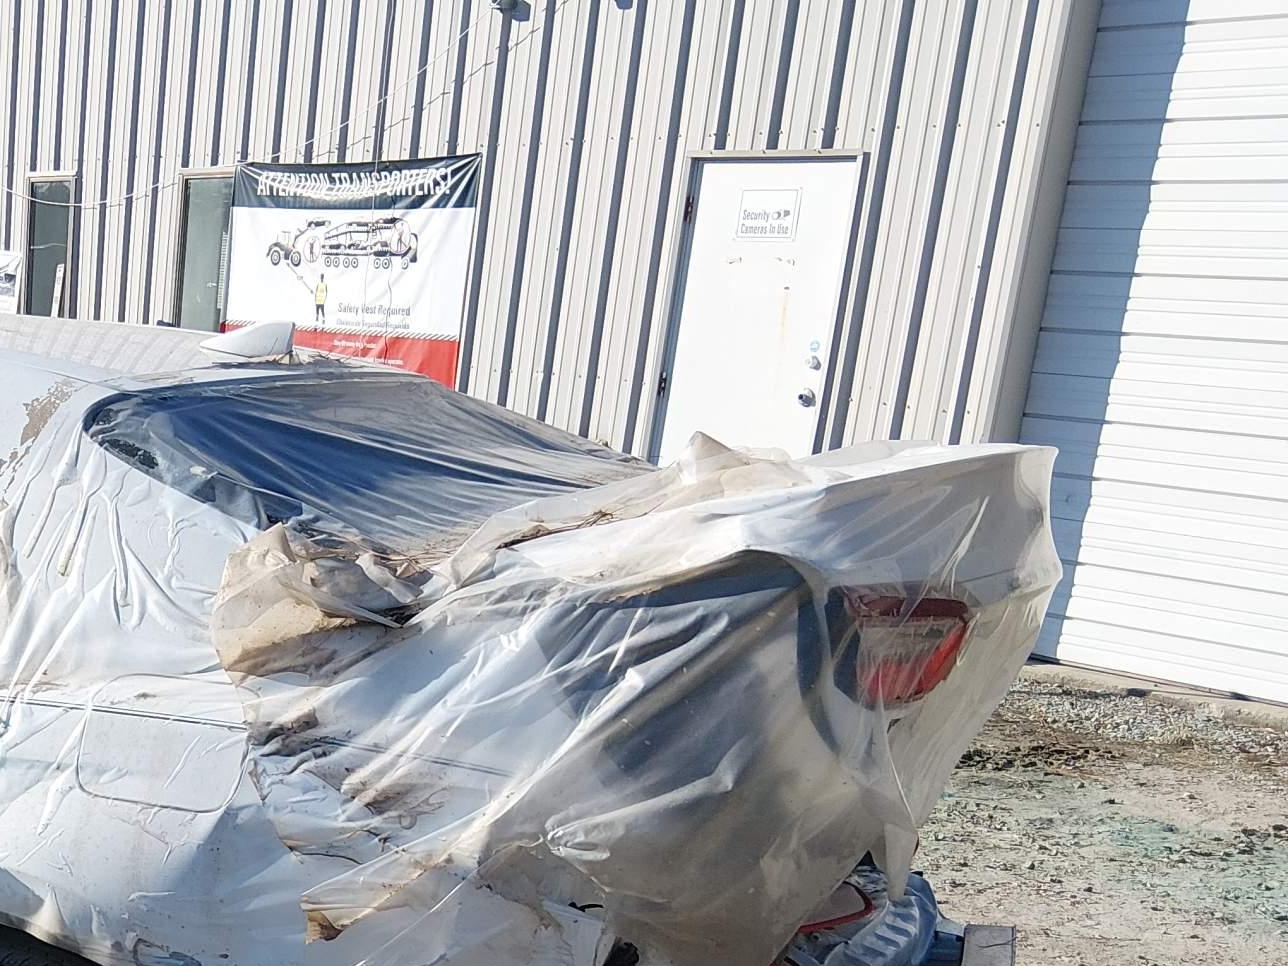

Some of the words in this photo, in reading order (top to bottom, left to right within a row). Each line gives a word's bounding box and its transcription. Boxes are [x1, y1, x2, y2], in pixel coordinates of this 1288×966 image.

[257, 171, 330, 200] ATTENTION
[330, 168, 452, 200] TRANSPORTERS!
[742, 209, 771, 223] Security
[740, 223, 768, 234] Cameras
[769, 223, 776, 234] In
[777, 223, 789, 235] Use
[338, 302, 360, 316] Safety
[361, 303, 377, 314] Vest
[377, 304, 411, 318] Required
